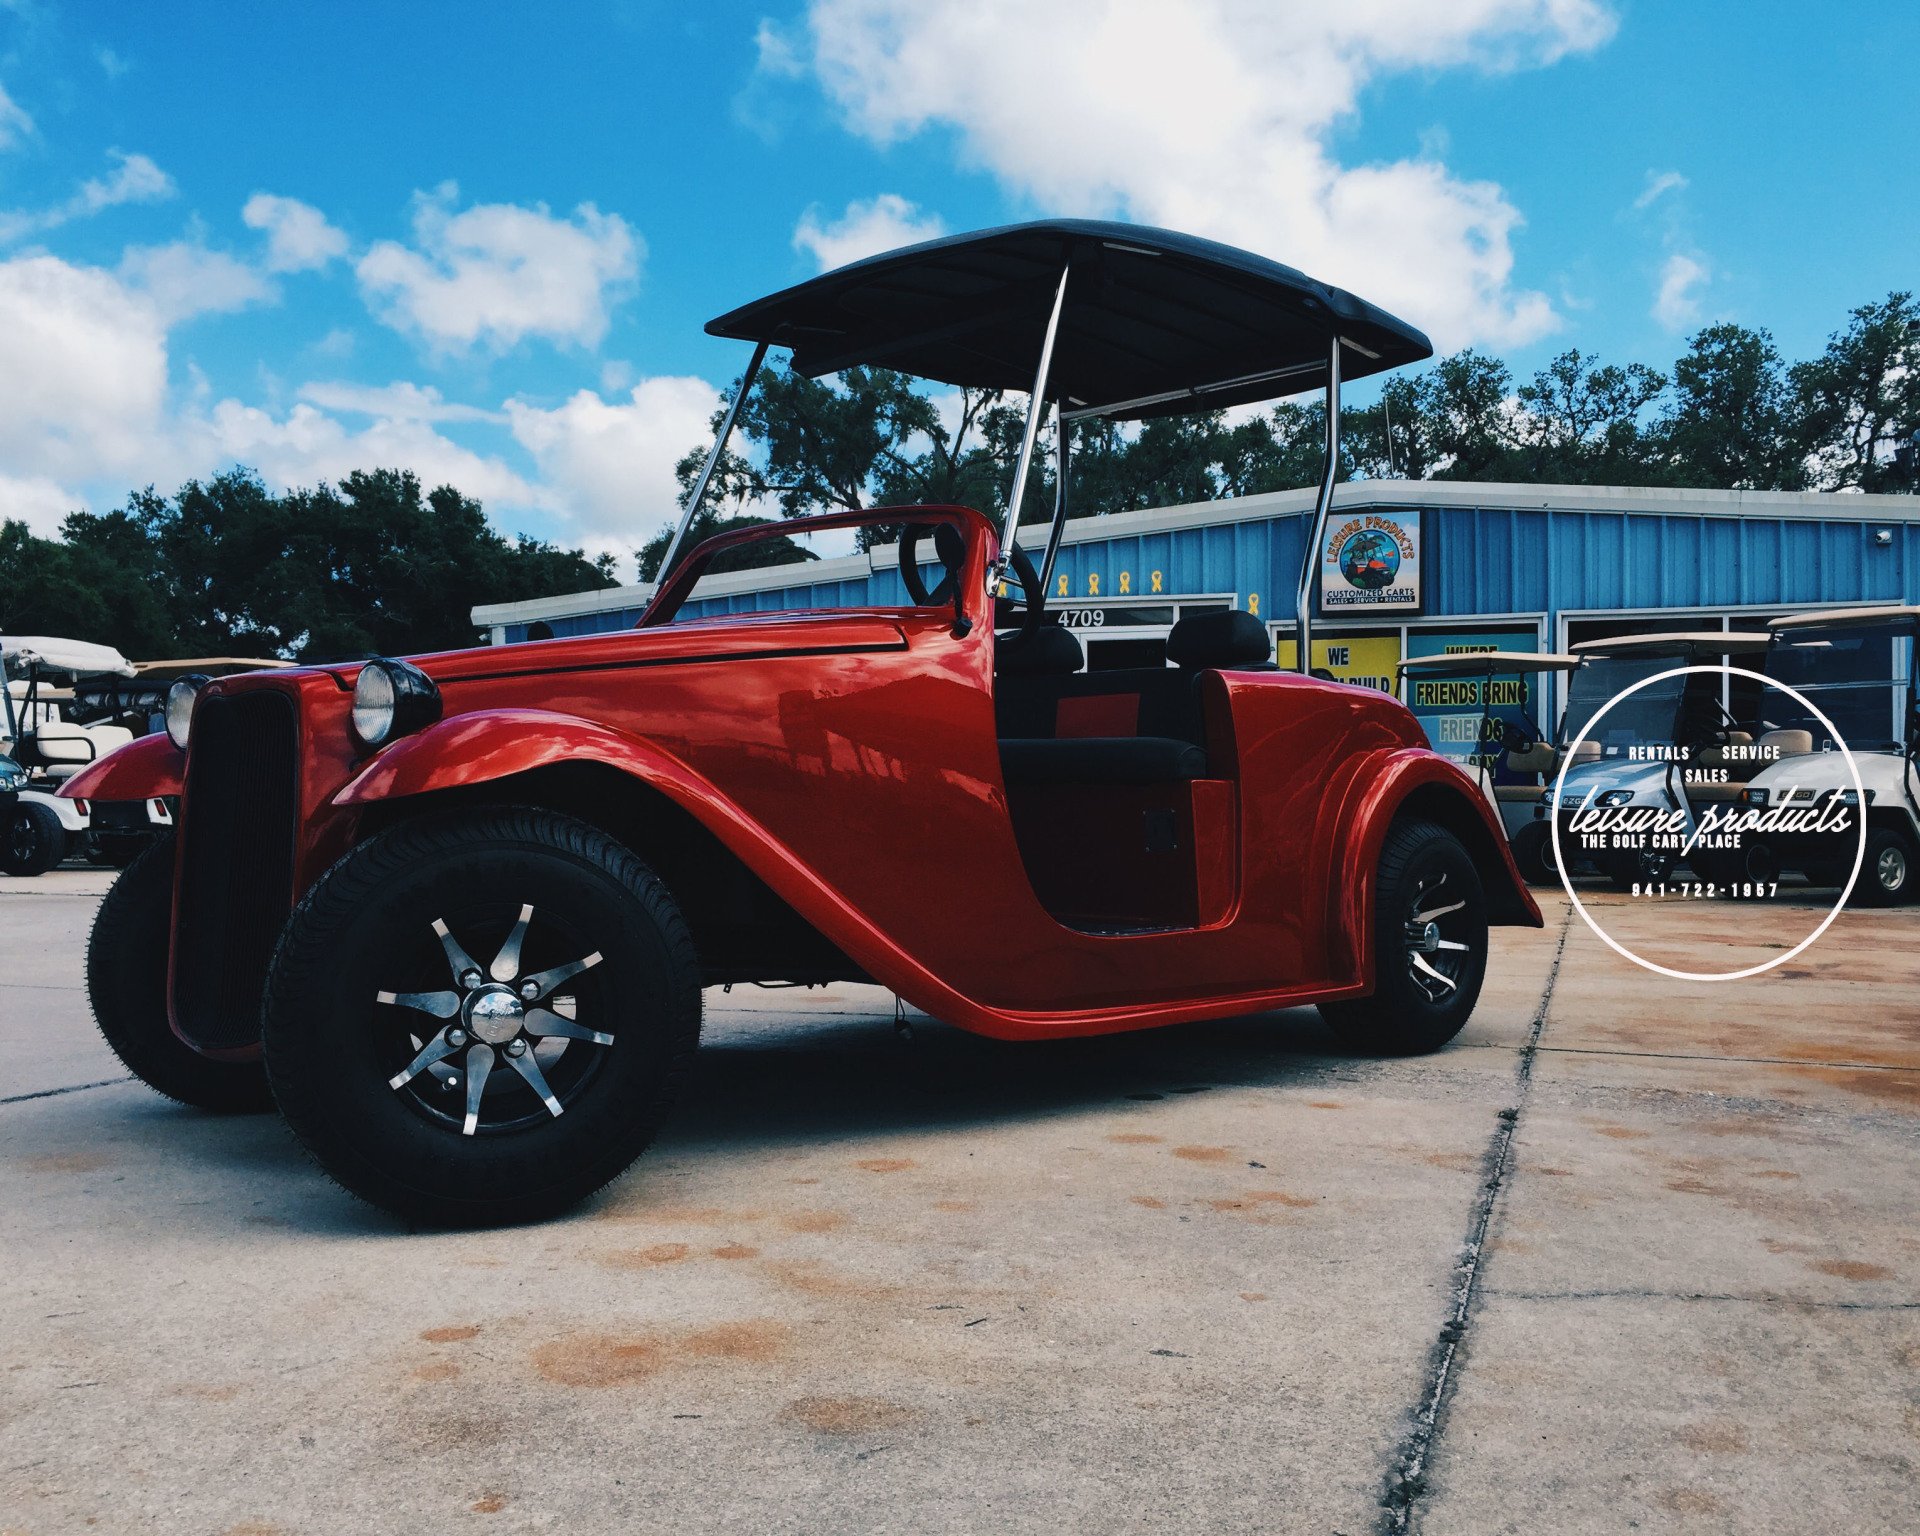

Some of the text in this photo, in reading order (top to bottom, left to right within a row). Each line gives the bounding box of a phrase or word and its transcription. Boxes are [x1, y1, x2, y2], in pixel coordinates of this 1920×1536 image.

[1326, 519, 1363, 564] LEISURE
[1327, 588, 1415, 598] CUSTOMIZED CARTS
[1057, 609, 1105, 628] 4709
[1327, 647, 1349, 666] WE
[1416, 681, 1479, 706] FRIENDS
